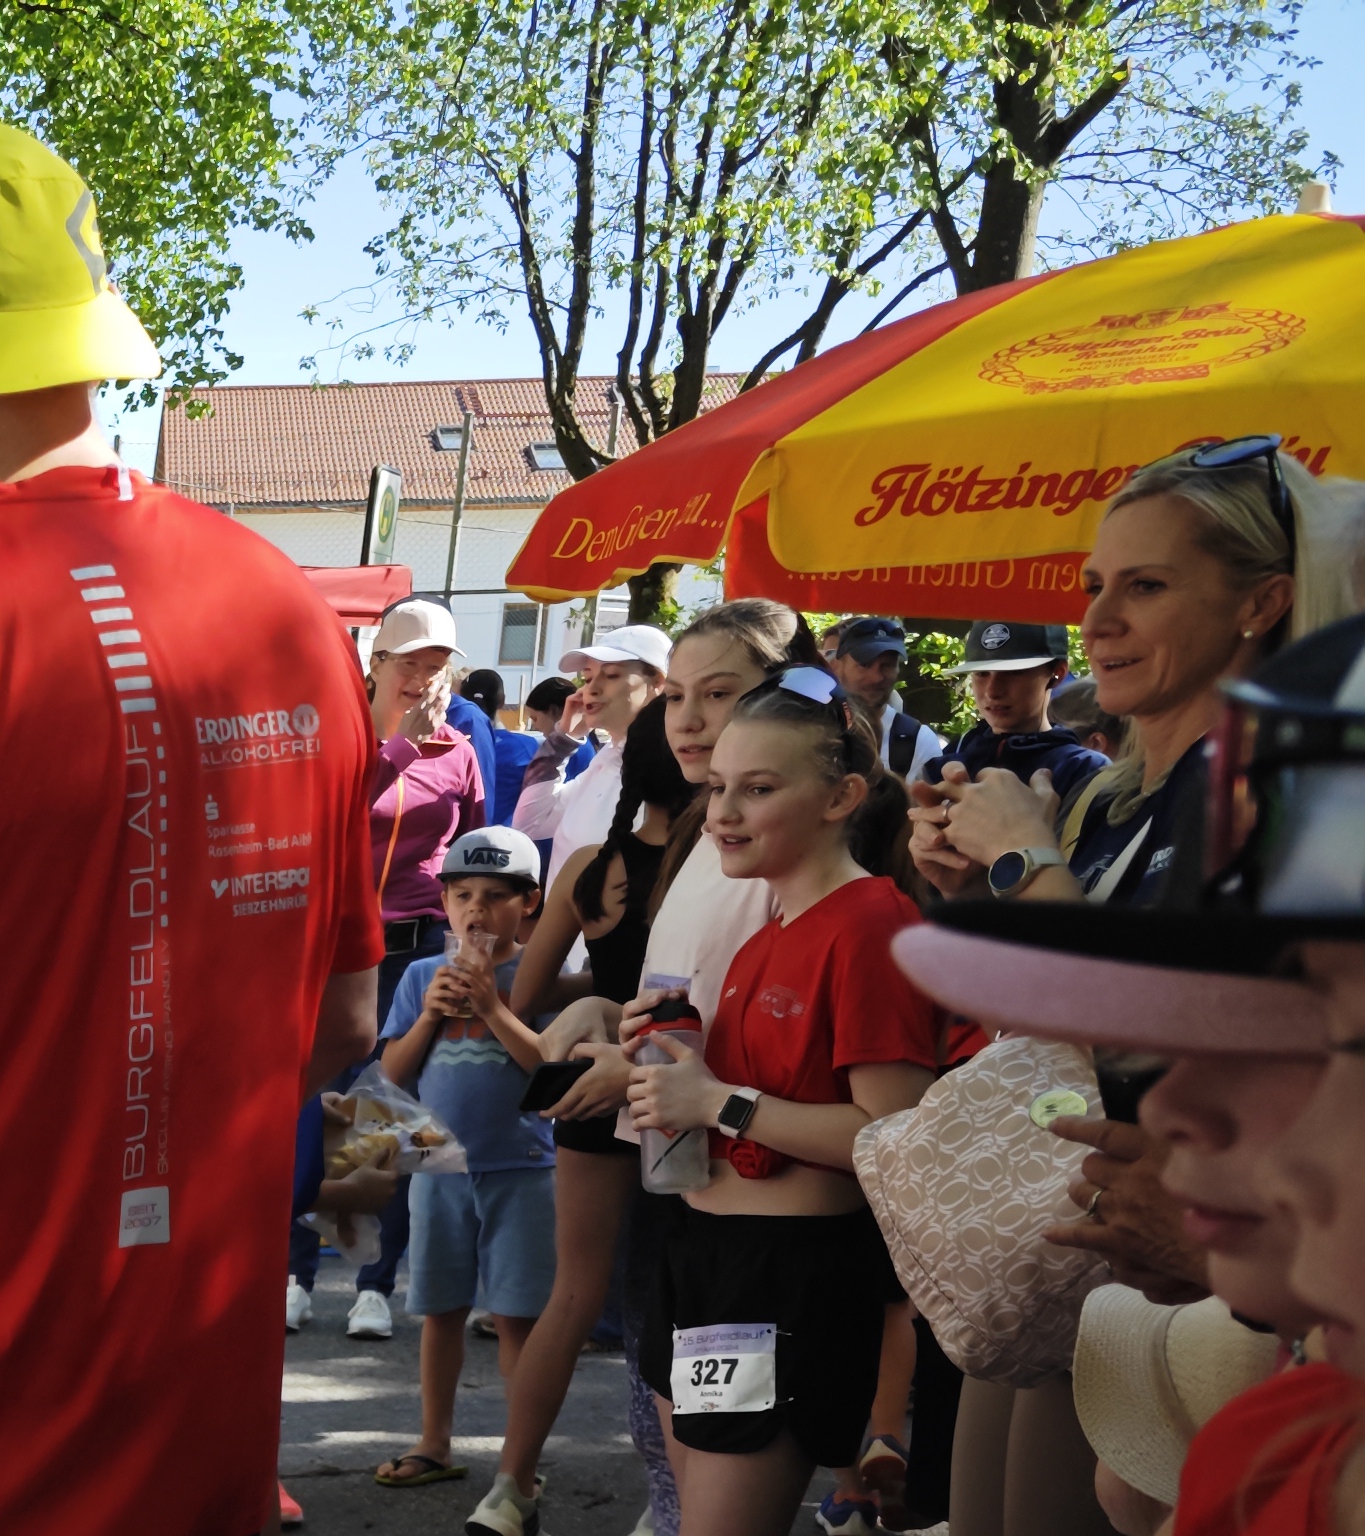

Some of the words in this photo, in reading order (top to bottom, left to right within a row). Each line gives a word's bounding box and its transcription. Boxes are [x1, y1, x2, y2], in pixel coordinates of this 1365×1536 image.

[550, 517, 618, 563] Dem
[195, 710, 294, 745] ERDINGER
[199, 738, 320, 766] ALKOHOLFREI
[206, 822, 256, 838] Sparkasse
[464, 847, 512, 868] VANS
[122, 723, 155, 1181] BURGFELDLAUF
[696, 1329, 767, 1345] Burgfeldlauf
[690, 1358, 739, 1387] 327
